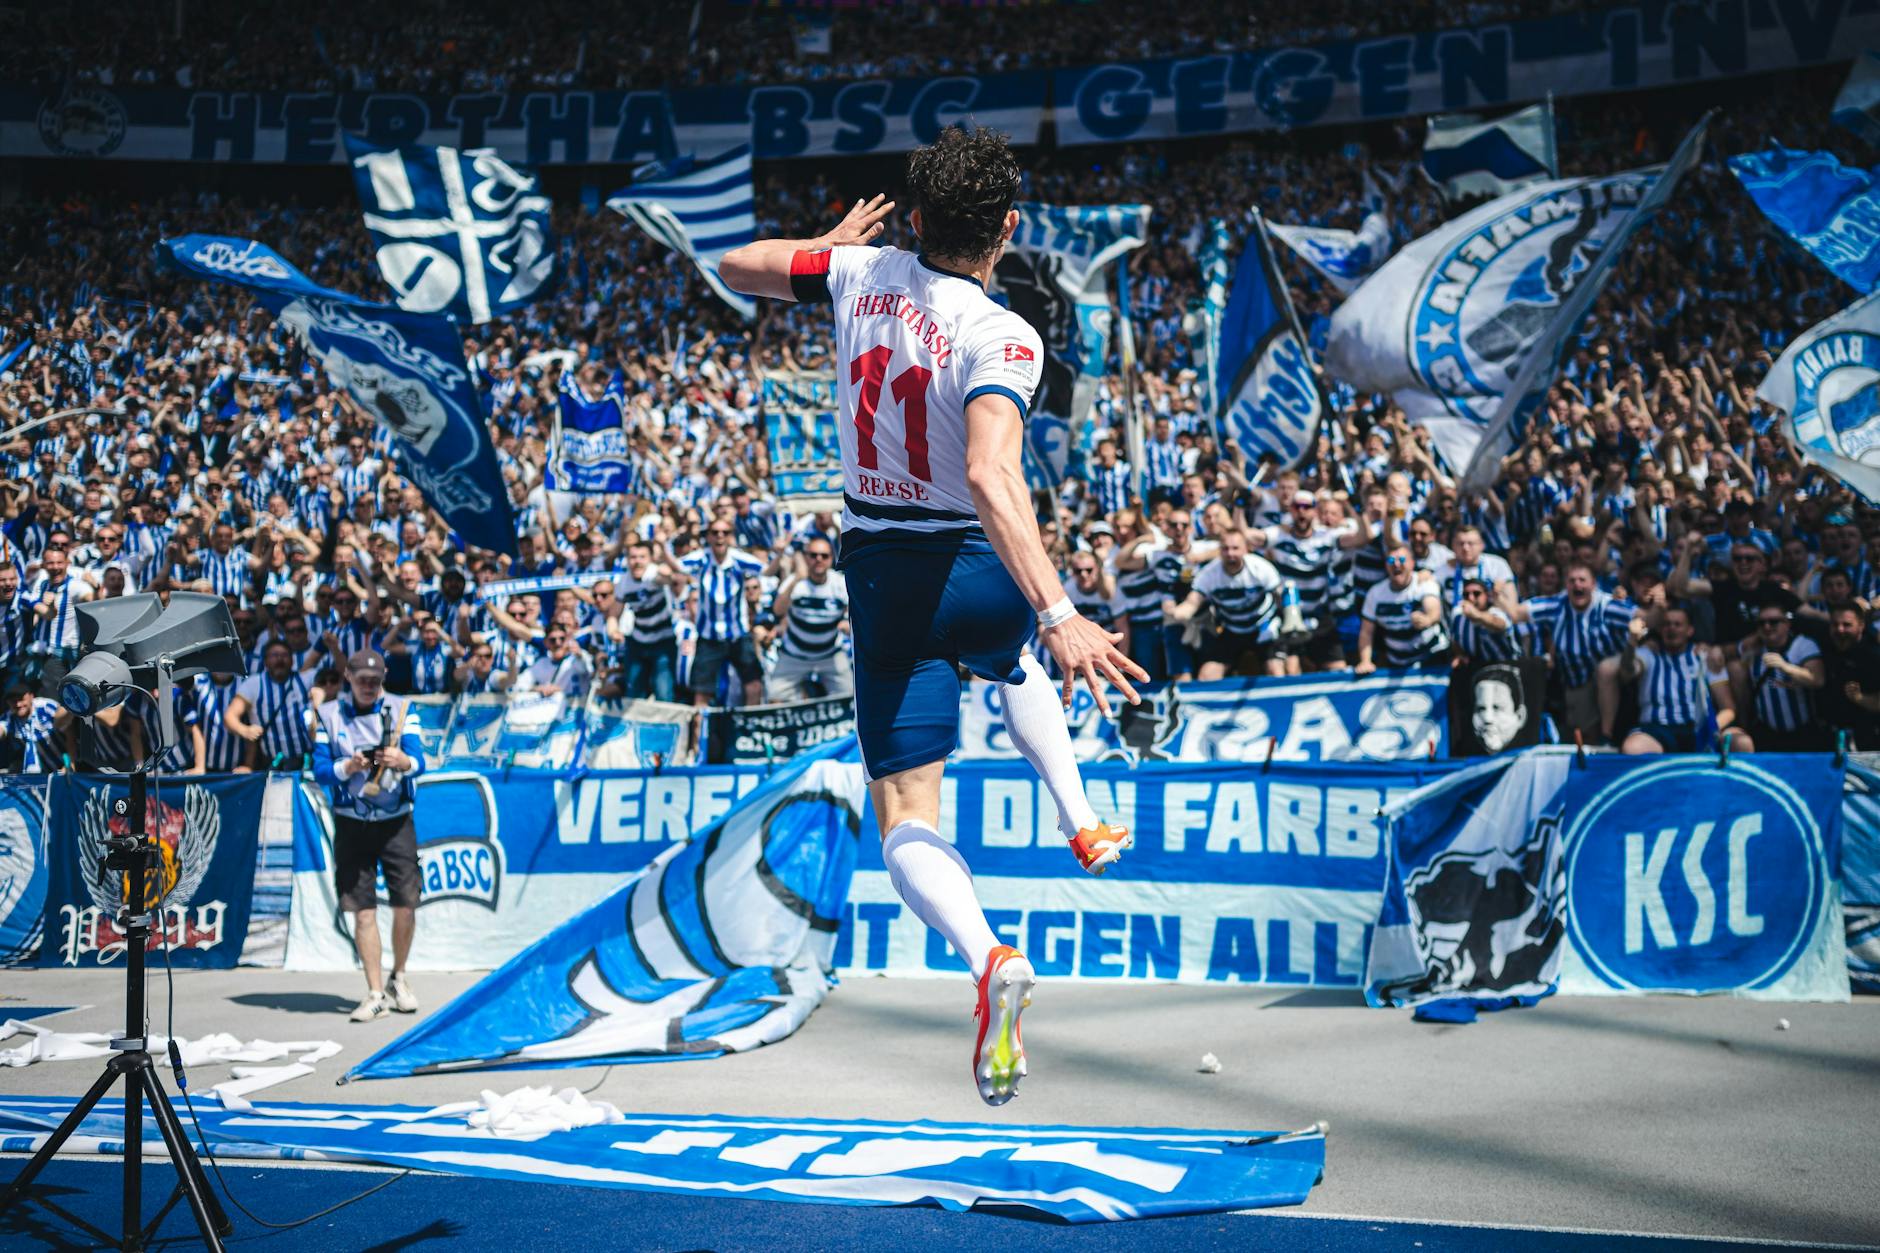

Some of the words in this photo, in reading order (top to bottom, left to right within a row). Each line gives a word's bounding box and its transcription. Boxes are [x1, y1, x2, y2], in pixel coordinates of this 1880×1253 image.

[188, 91, 682, 163] HERTHA
[748, 75, 982, 157] BSC
[1075, 24, 1512, 138] GEGEN
[850, 344, 933, 483] 11
[858, 474, 930, 501] REESE
[1625, 811, 1765, 955] KSC
